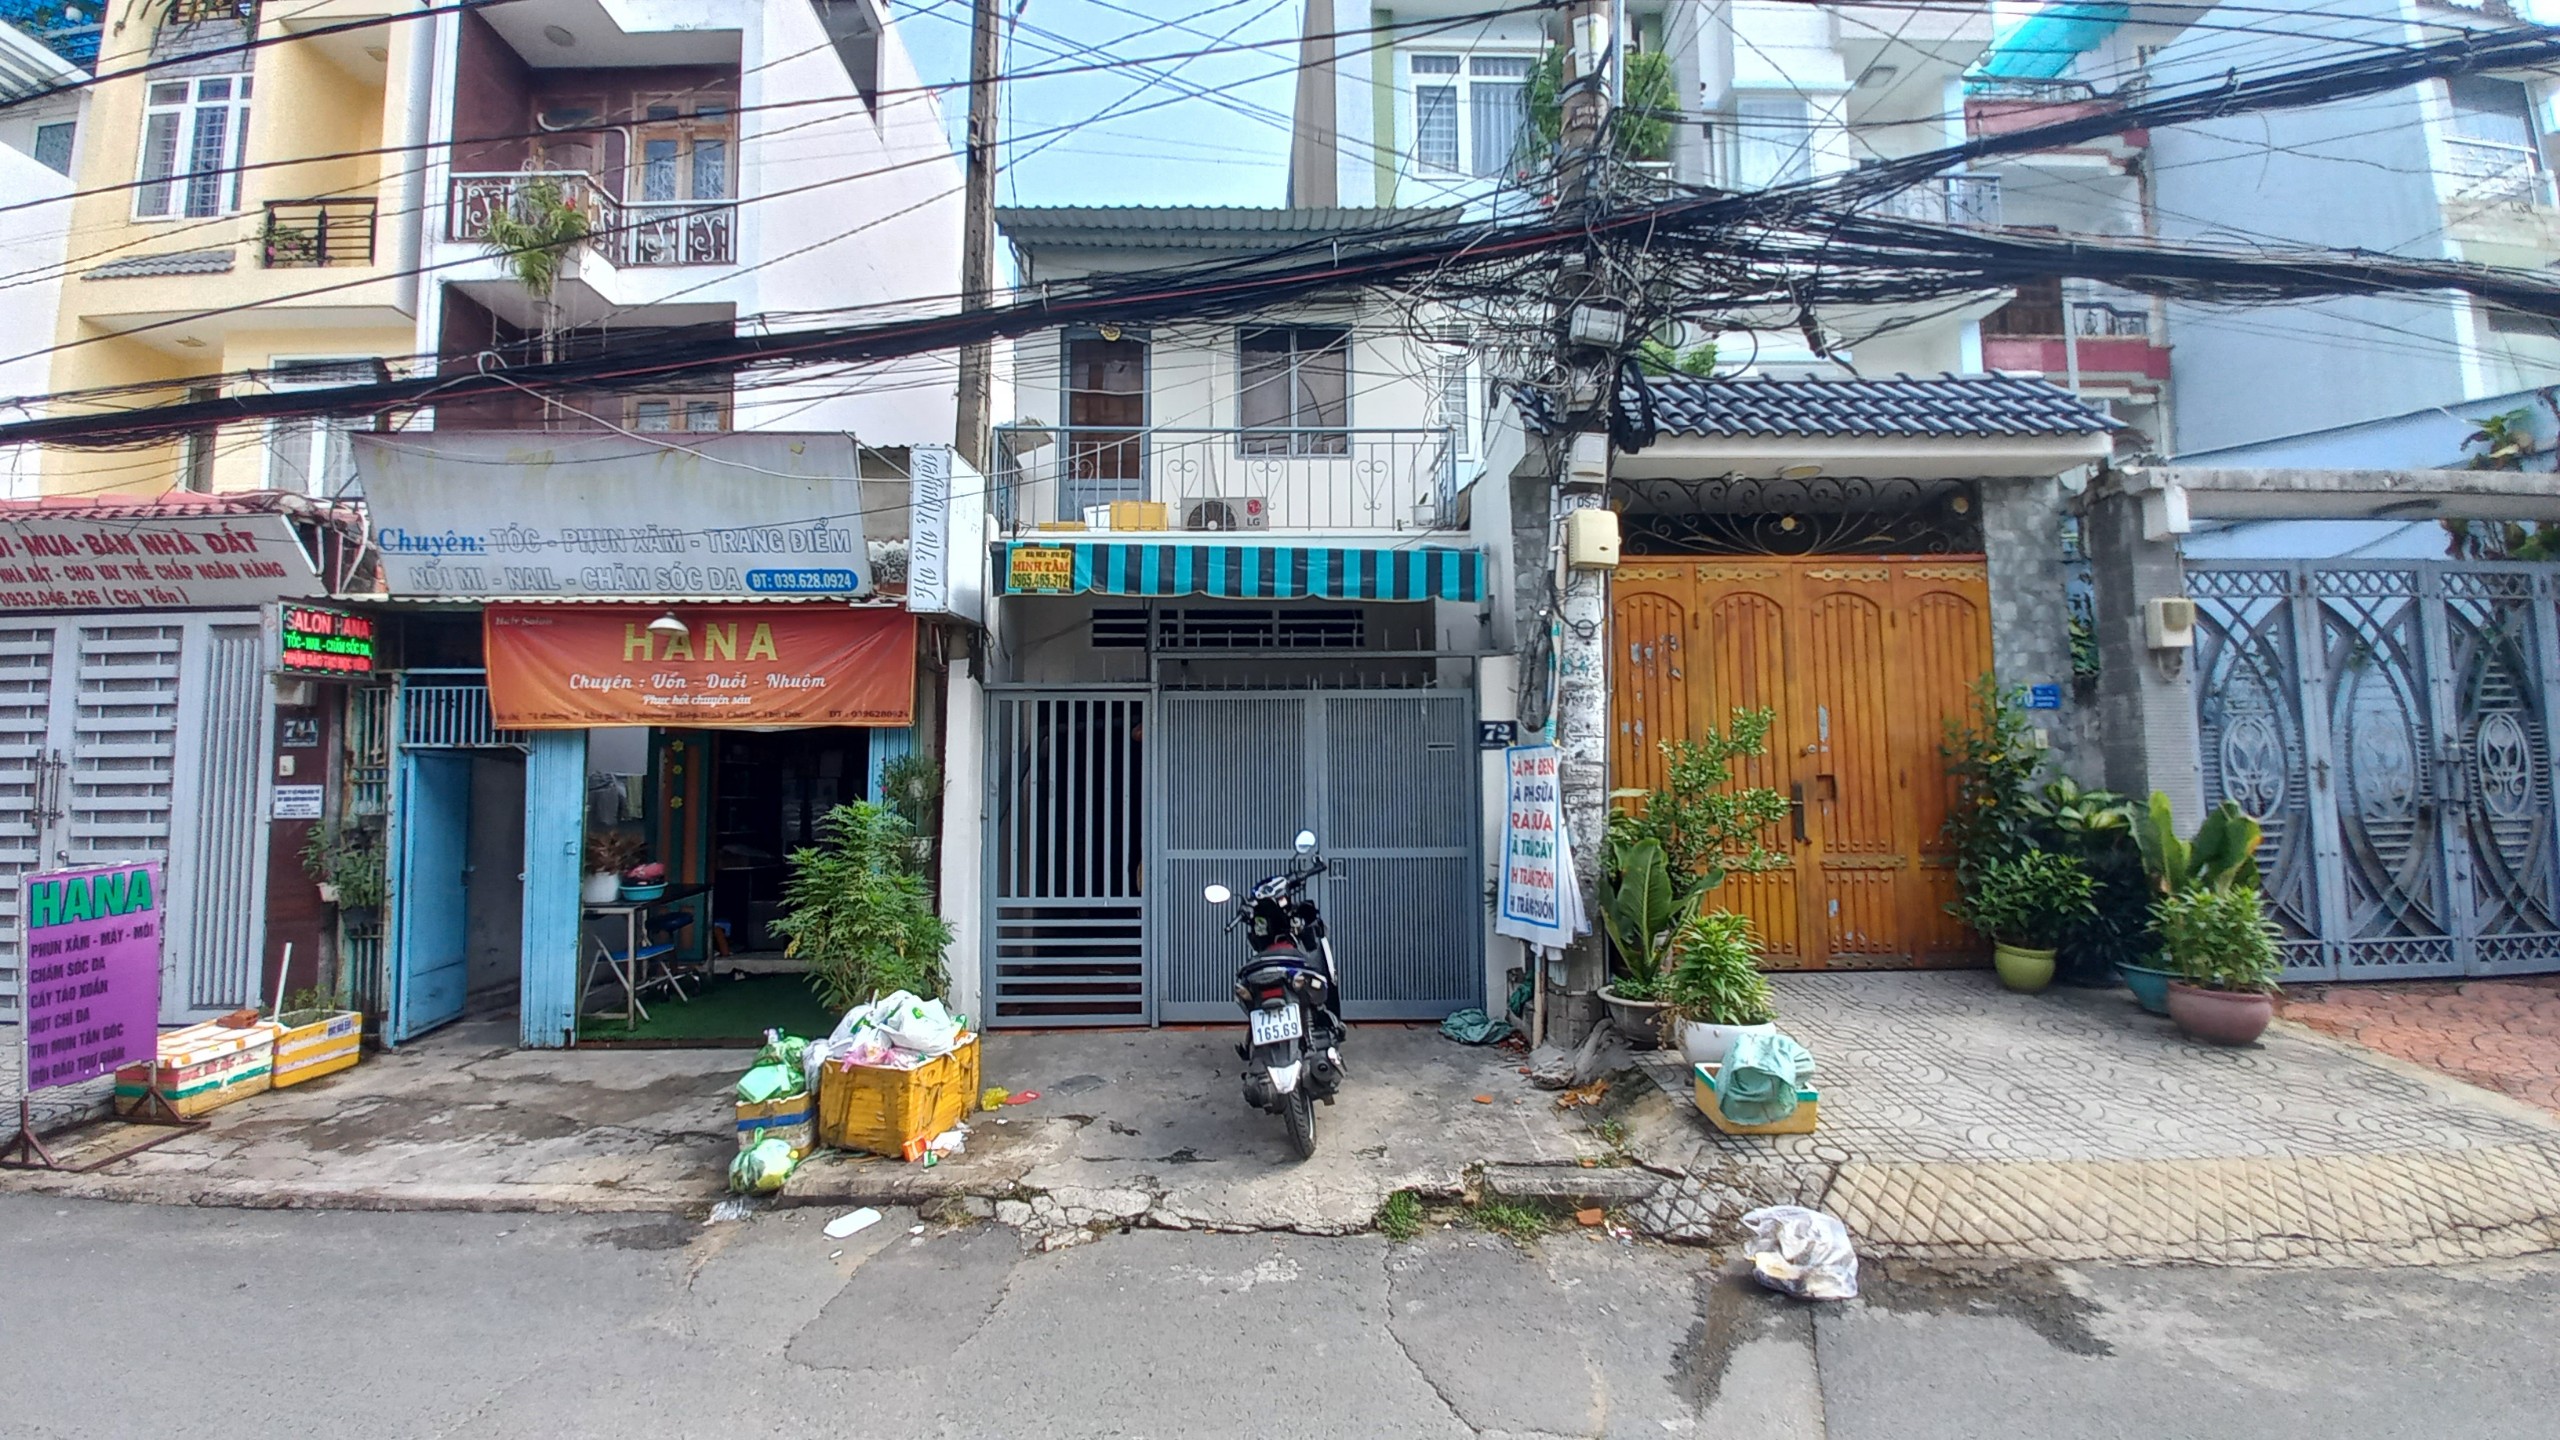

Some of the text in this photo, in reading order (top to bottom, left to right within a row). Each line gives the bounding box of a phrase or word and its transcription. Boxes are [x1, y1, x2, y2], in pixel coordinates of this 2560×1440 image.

[1247, 517, 1260, 526] LG
[21, 534, 80, 557] MUA
[84, 529, 140, 556] BÁN
[137, 528, 201, 555] NHÀ
[203, 522, 259, 554] ĐẤT
[378, 528, 487, 557] Chuyên:
[704, 528, 786, 554] TRANG
[790, 517, 852, 553] ĐIỂM
[0, 563, 27, 583] NHÀ
[64, 565, 95, 581] CHO
[95, 564, 125, 580] VAY
[122, 558, 154, 580] THẾ
[154, 558, 193, 580] CHẤP
[196, 561, 241, 579] NGÂN
[241, 559, 287, 578] HÀNG
[455, 567, 488, 591] MI
[504, 567, 561, 591] NAIL
[581, 562, 650, 591] CHĂM
[655, 561, 703, 591] SÓC
[707, 567, 742, 590] DA
[774, 572, 852, 589] 039.628.0924
[1013, 560, 1042, 572] MINH
[286, 609, 371, 640] SALON HANA
[623, 623, 778, 661] HANA
[569, 671, 827, 693] Chuyên Uốn Duỗi Nhuộm
[1484, 723, 1511, 741] 72
[1512, 809, 1530, 830] RÀ
[30, 869, 154, 929] HANA
[91, 956, 106, 972] DA
[1257, 1022, 1298, 1042] 165.69
